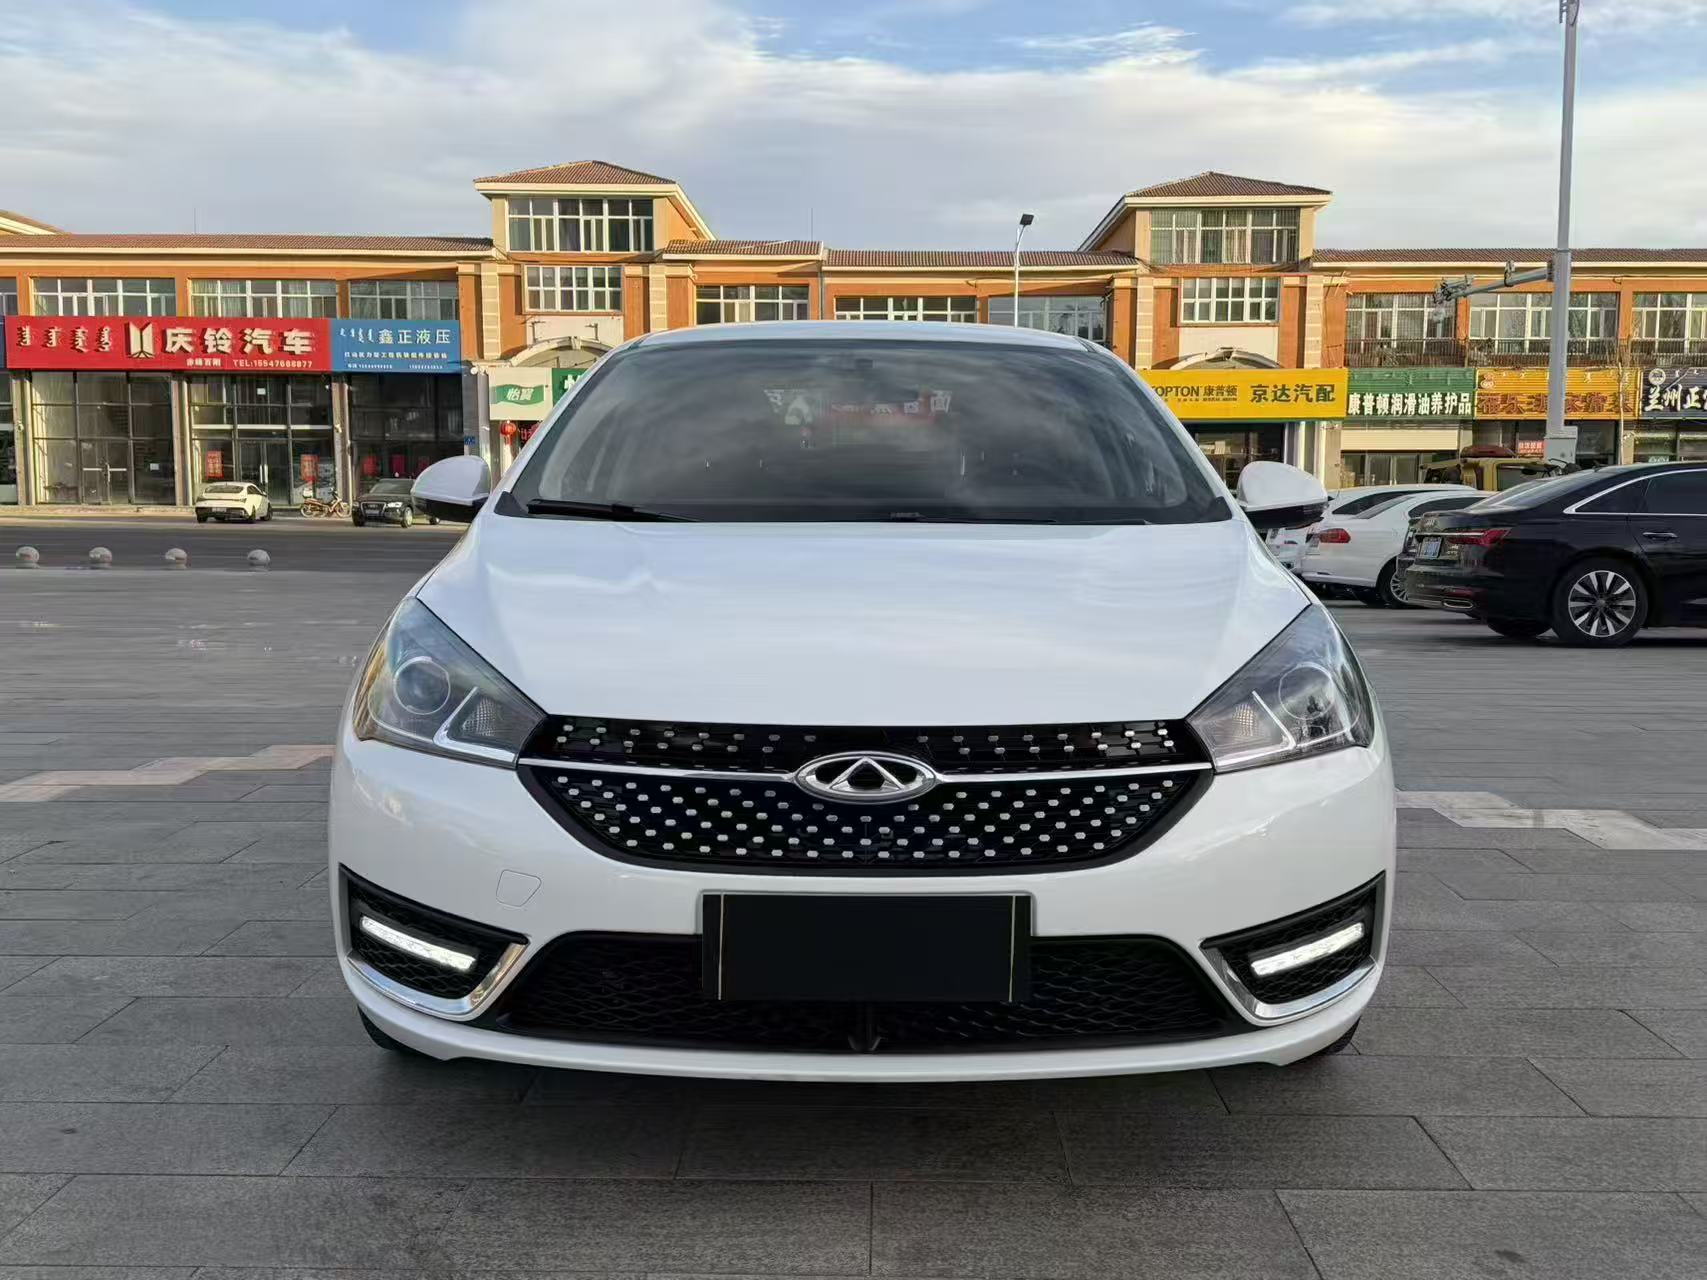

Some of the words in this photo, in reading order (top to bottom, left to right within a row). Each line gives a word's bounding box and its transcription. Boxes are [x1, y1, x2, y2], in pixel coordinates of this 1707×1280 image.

[164, 327, 313, 354] 庆铃汽车
[378, 328, 451, 344] 鑫正液压
[1152, 385, 1200, 397] OPTON
[1203, 385, 1238, 397] 康普顿
[1250, 383, 1336, 403] 京达汽配
[1347, 391, 1472, 416] 康普顿润滑油养护品
